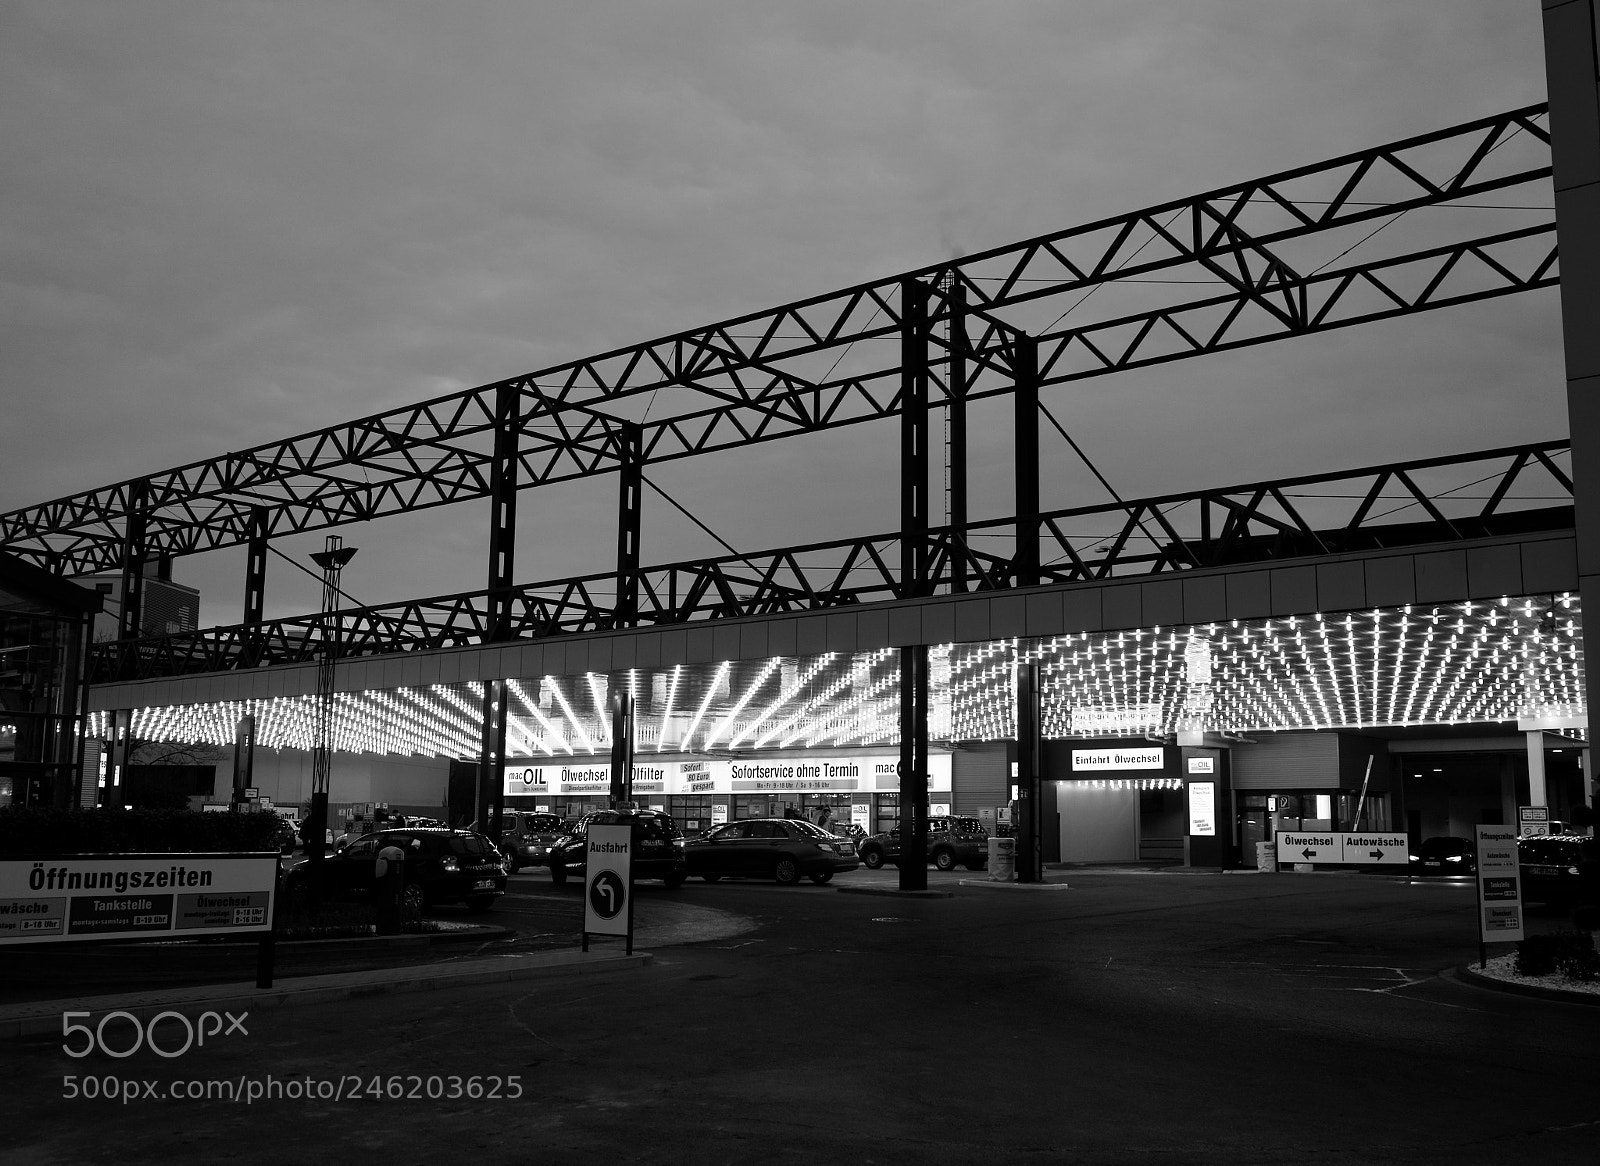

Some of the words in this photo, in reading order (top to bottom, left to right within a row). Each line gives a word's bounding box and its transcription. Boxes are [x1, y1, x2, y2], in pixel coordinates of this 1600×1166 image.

[1075, 755, 1110, 765] Einfahrt
[1114, 753, 1161, 764] Ölwechsel
[561, 767, 608, 782] Ölwechsel
[631, 764, 665, 781] Ölfilter
[683, 763, 701, 772] Sofort
[731, 763, 794, 779] Sofortservice
[796, 763, 821, 778] ohne
[824, 762, 859, 777] Termin
[696, 772, 710, 781] Euro
[692, 781, 715, 793] gespart
[281, 812, 295, 820] ahrt
[1284, 835, 1334, 846] Ölwechsel
[1346, 837, 1405, 847] Autowäsche
[589, 841, 628, 854] Ausfahrt
[29, 862, 212, 893] Öffnungszeiten
[0, 902, 49, 914] wäsche
[93, 899, 152, 912] Tankstelle
[197, 896, 250, 908] Ölwechsel
[44, 920, 57, 928] Uhr
[153, 915, 166, 923] Uhr
[251, 915, 262, 923] Uhr
